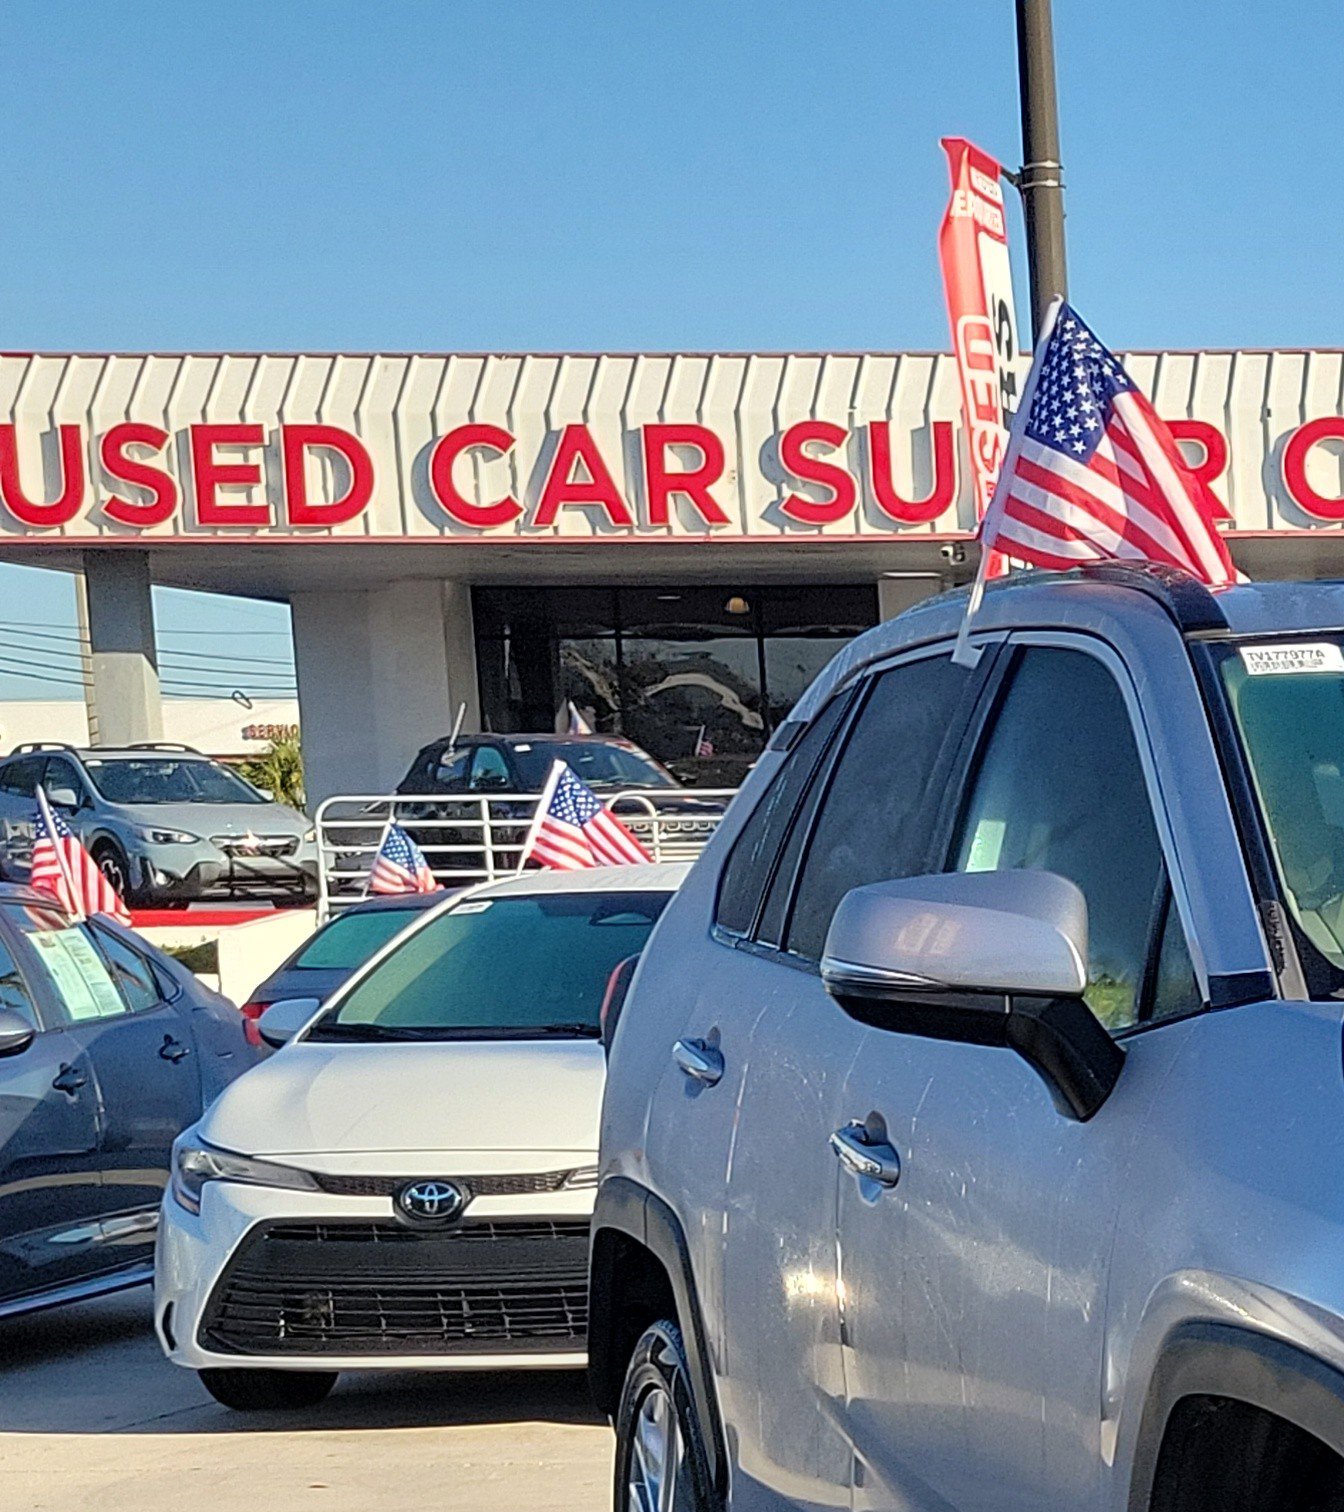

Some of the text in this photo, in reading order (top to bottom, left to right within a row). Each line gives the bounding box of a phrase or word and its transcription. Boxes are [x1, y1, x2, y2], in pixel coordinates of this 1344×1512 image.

[0, 422, 375, 527] USED
[429, 422, 733, 527] CAR
[778, 419, 1235, 526] SUR
